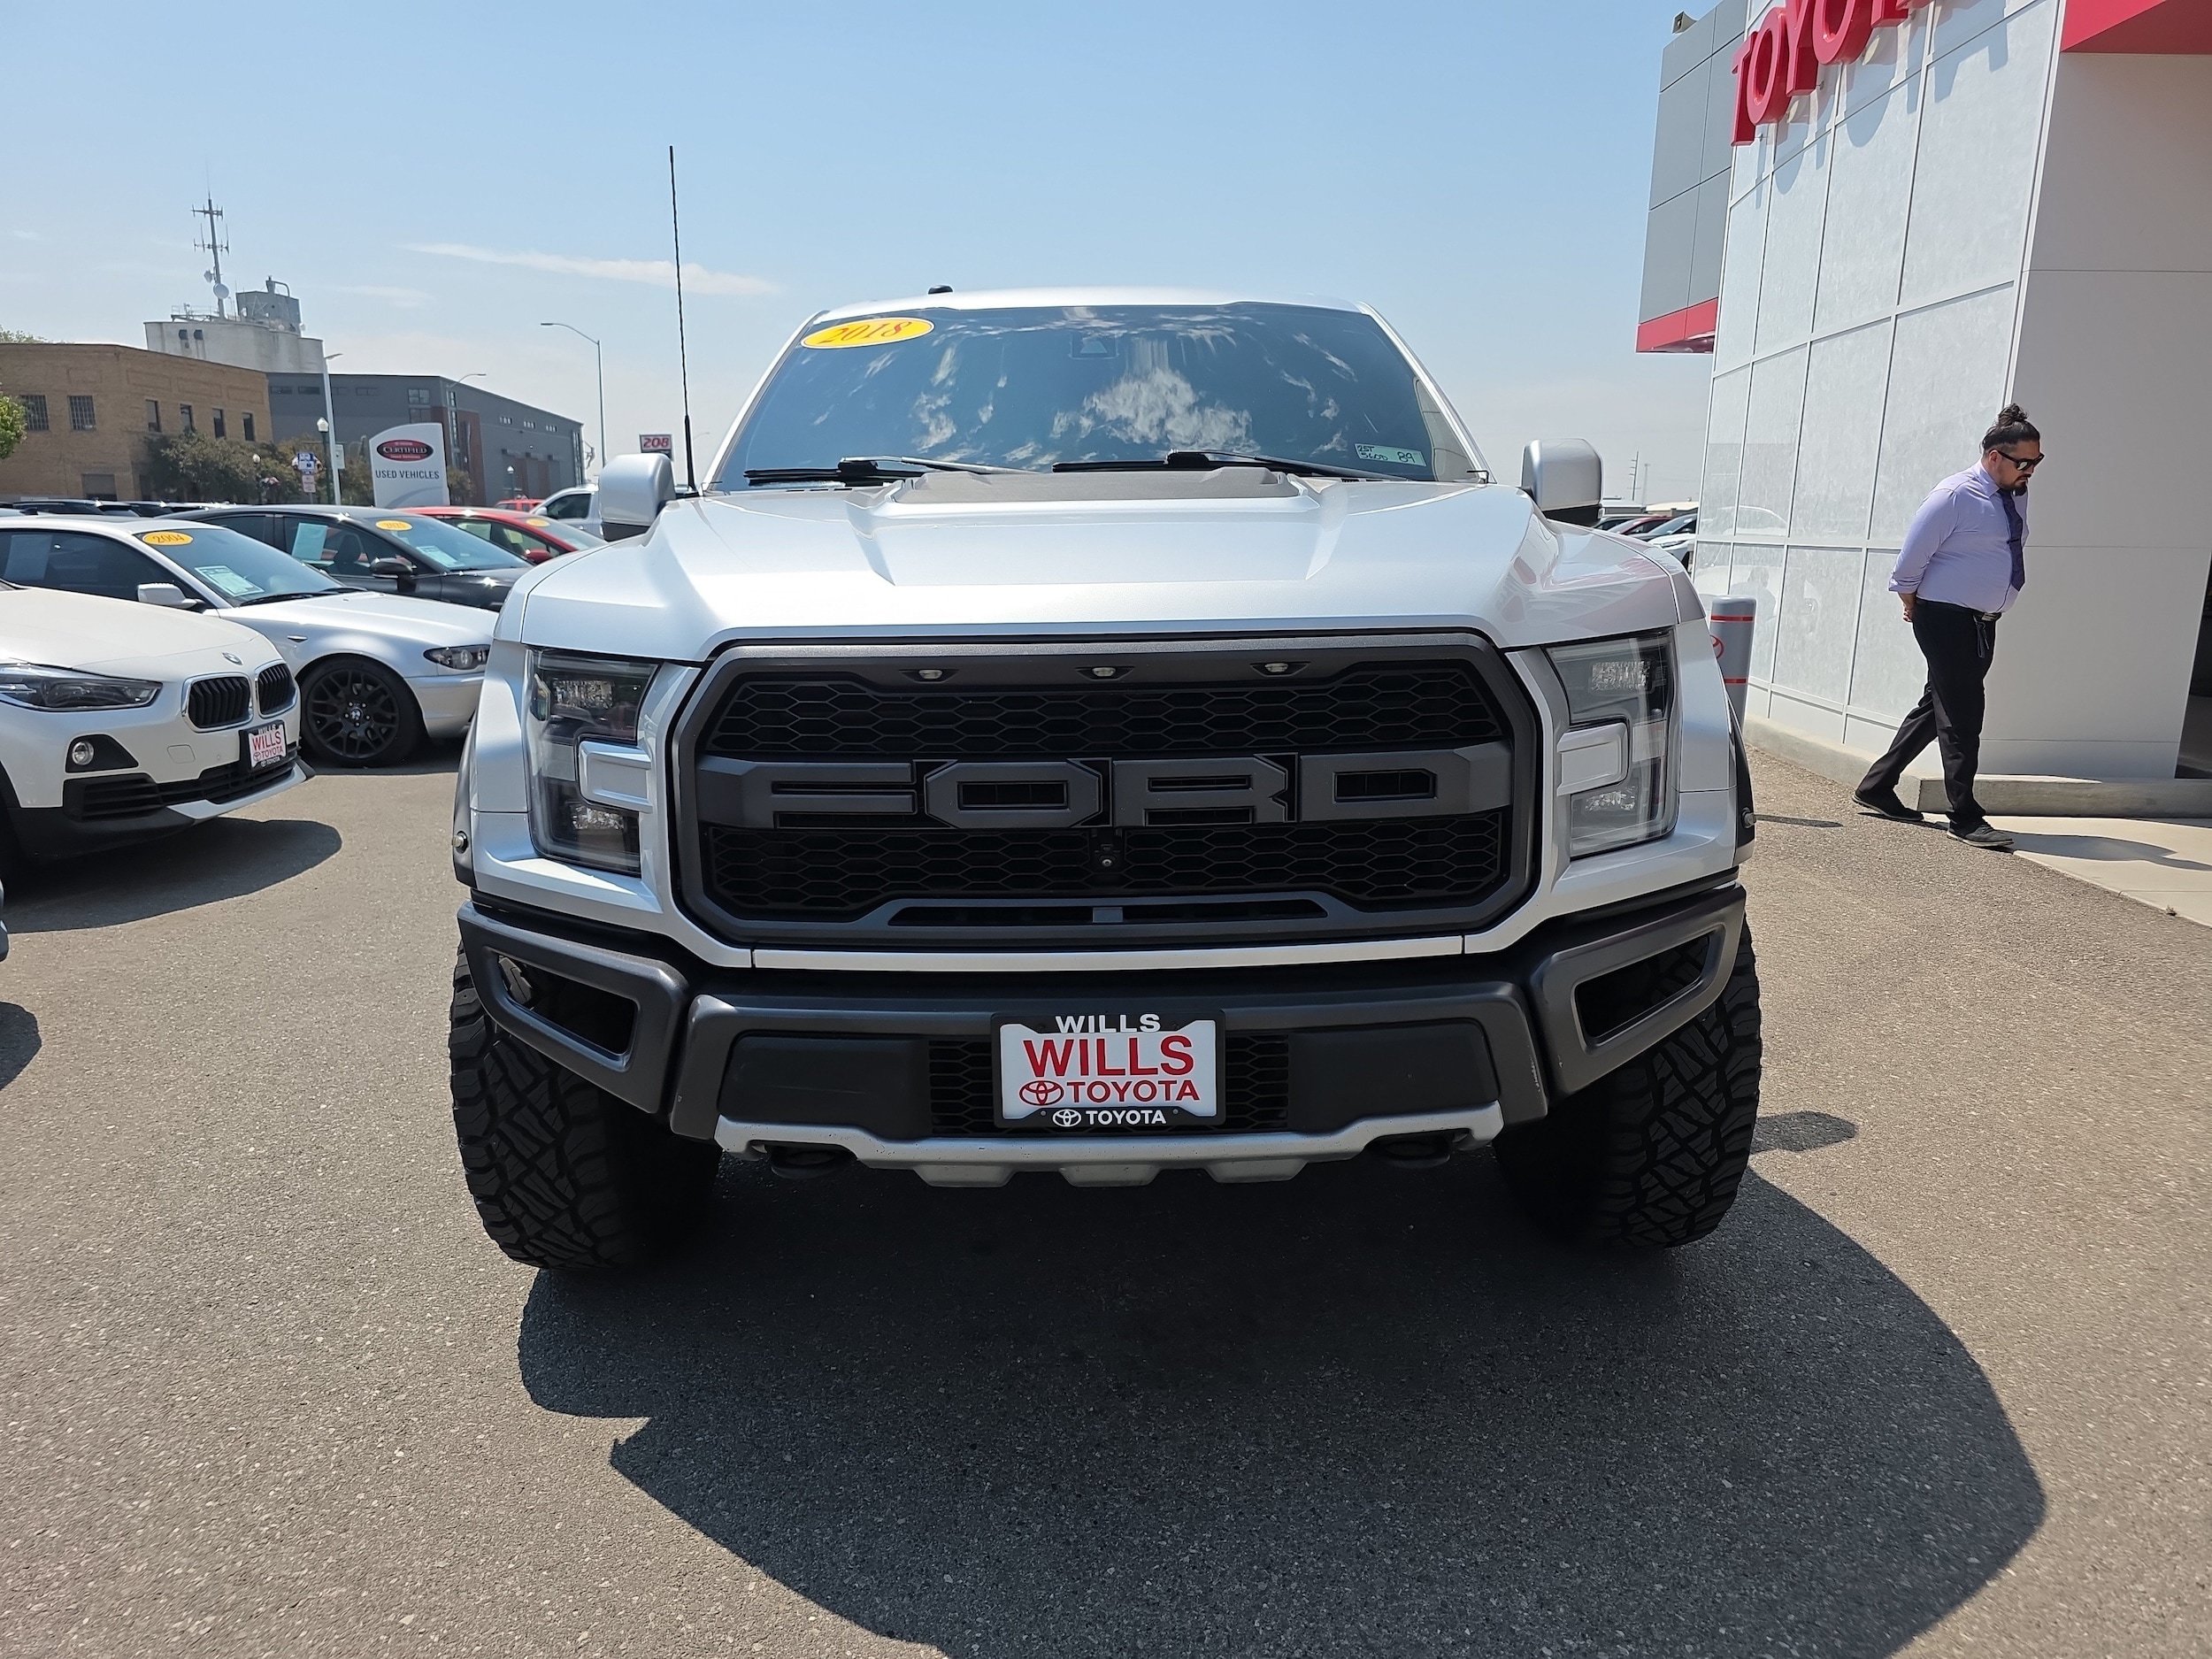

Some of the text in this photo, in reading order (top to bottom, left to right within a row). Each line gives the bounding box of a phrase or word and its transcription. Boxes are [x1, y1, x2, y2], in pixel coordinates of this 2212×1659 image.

[1732, 0, 1939, 146] TOYO
[816, 320, 912, 345] 2018
[643, 437, 670, 449] 208
[1397, 451, 1416, 463] 89
[375, 470, 440, 480] USED VEHICLES
[152, 534, 185, 543] 2004
[252, 731, 281, 751] WILLS
[261, 745, 284, 758] TOYOTA
[697, 740, 1513, 830] FORD
[1056, 1013, 1161, 1033] WILLS
[1023, 1035, 1194, 1078] WILLS
[1067, 1079, 1200, 1103] TOYOTA
[1086, 1110, 1166, 1125] TOYOTA
